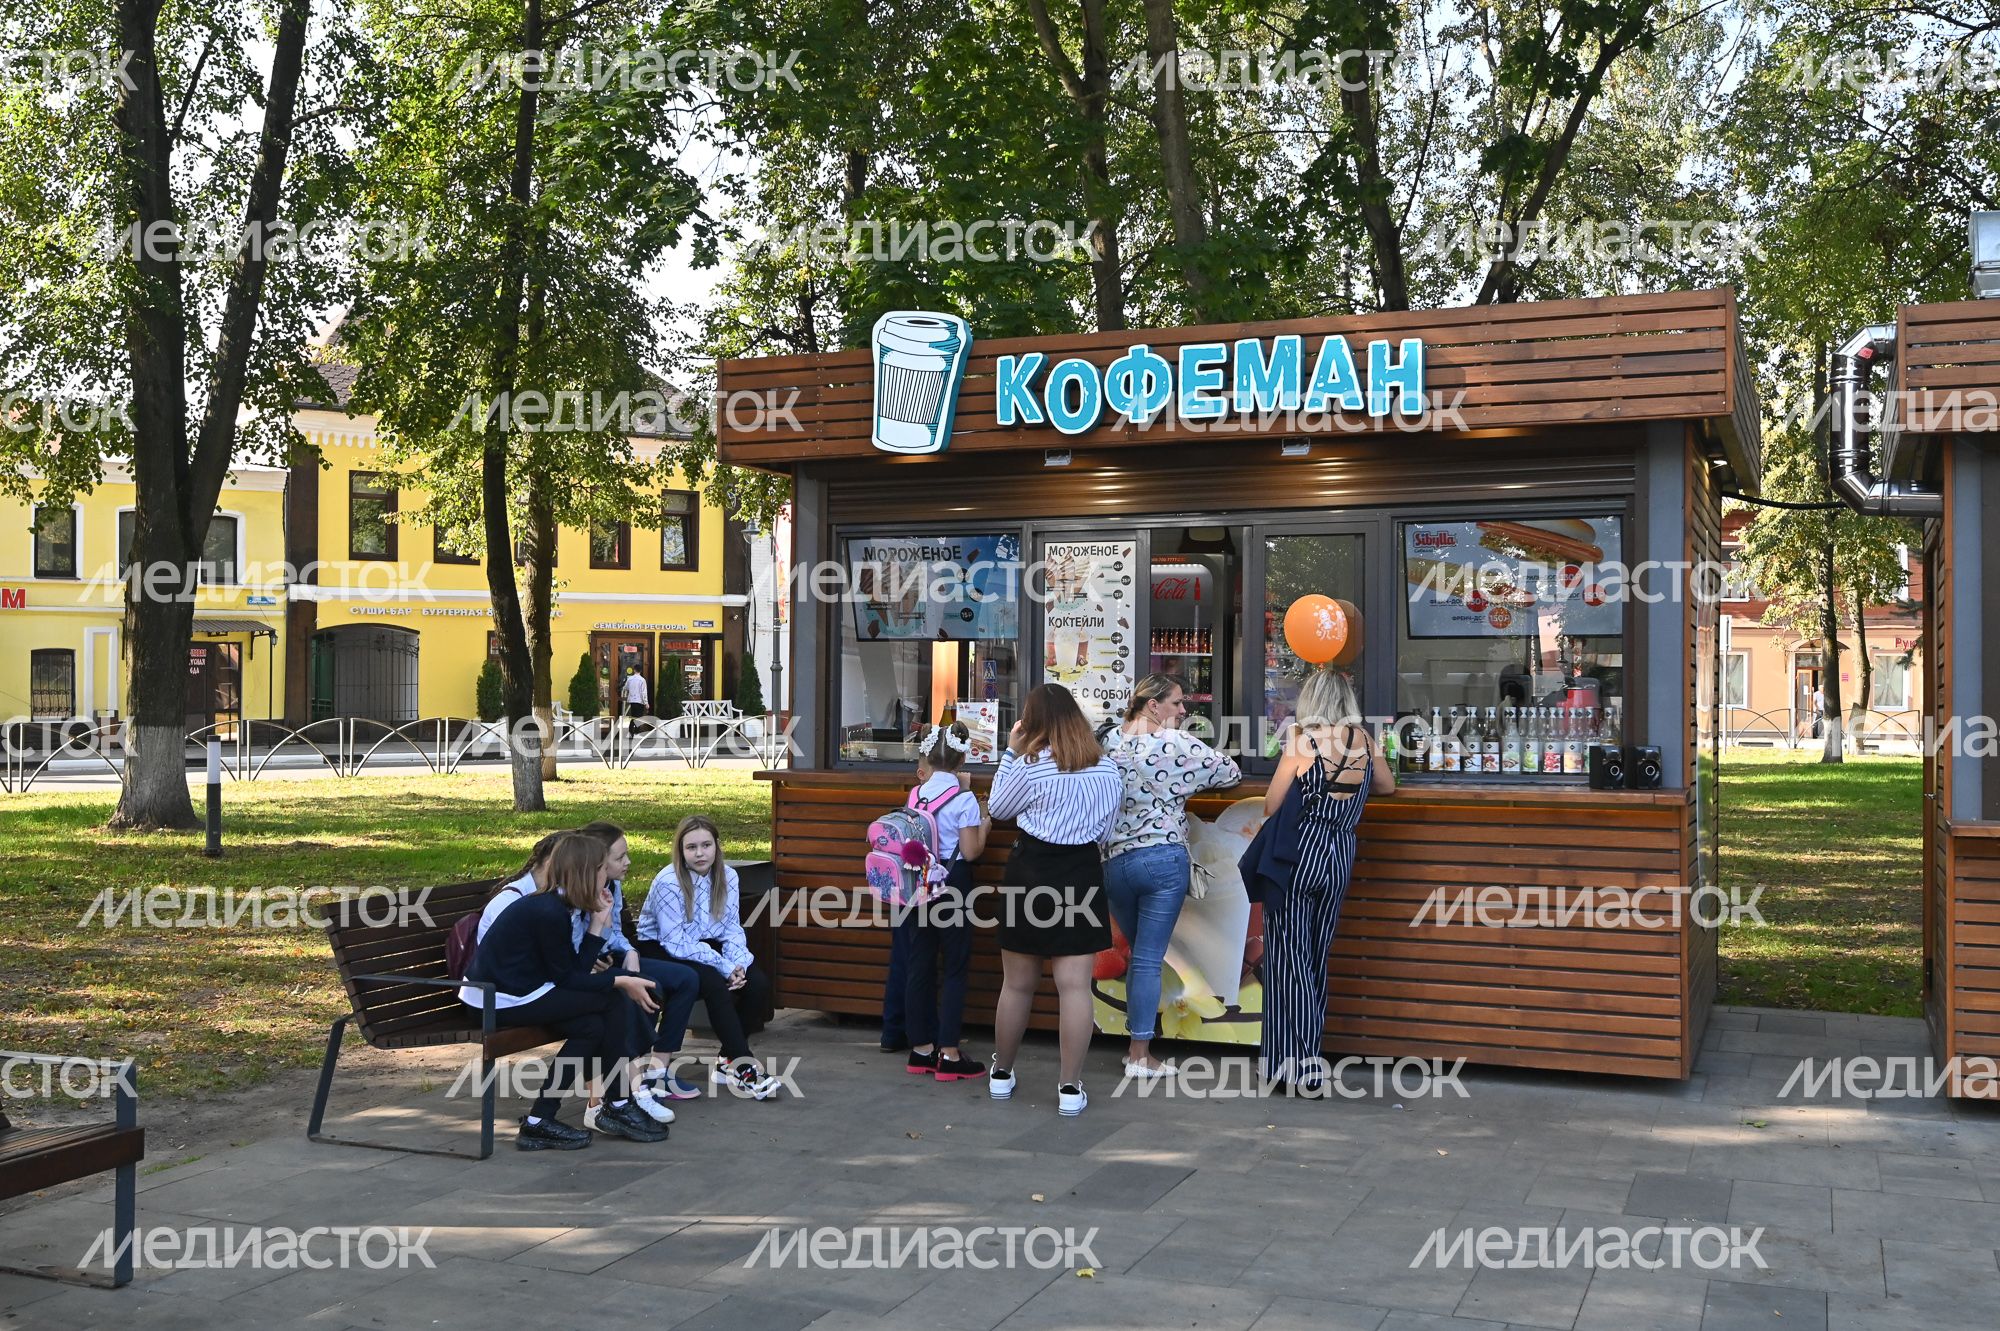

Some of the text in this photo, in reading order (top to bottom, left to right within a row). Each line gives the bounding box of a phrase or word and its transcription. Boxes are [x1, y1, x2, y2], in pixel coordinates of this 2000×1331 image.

[996, 333, 1426, 437] КОФЕМАН
[1414, 531, 1456, 549] Sibylla
[863, 545, 962, 562] МОРОЖЕНОЕ
[1048, 545, 1119, 557] МОРОЖЕНОЕ
[349, 606, 412, 616] СУШИ-БАР
[422, 607, 483, 617] БУРГЕРНАЯ
[593, 622, 641, 630] СЕМЕЙНЫЙ
[644, 623, 688, 631] РЕСТОРАН
[1048, 615, 1105, 629] КОКТЕЙЛИ
[1093, 687, 1131, 700] СОБОЙ
